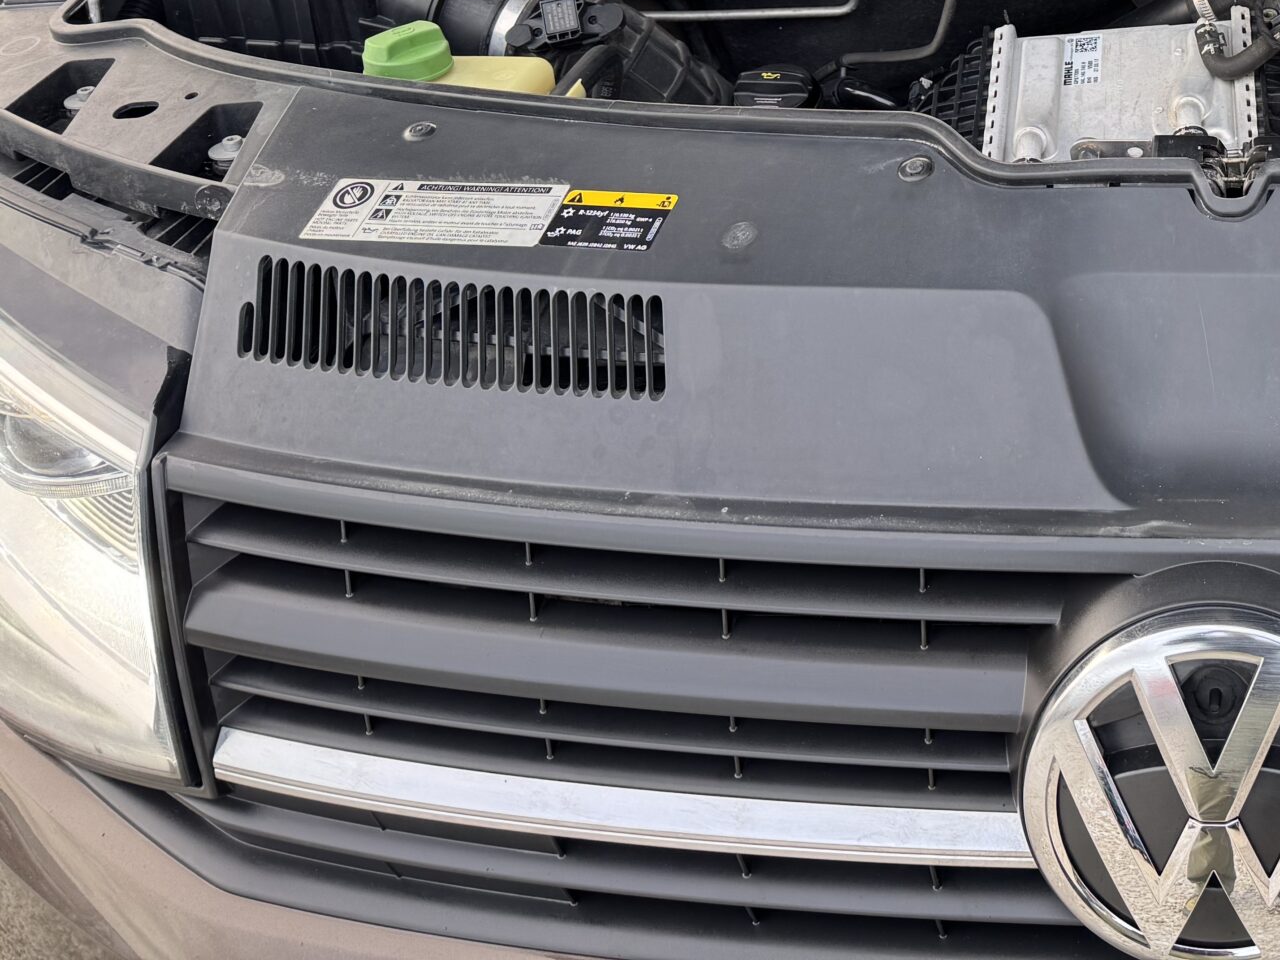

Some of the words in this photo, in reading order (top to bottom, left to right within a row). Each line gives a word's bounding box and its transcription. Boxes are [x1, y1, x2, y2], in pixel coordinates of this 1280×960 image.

[1064, 61, 1073, 86] MAHLE
[463, 185, 503, 193] WARNING!
[578, 209, 609, 218] R-1234yf
